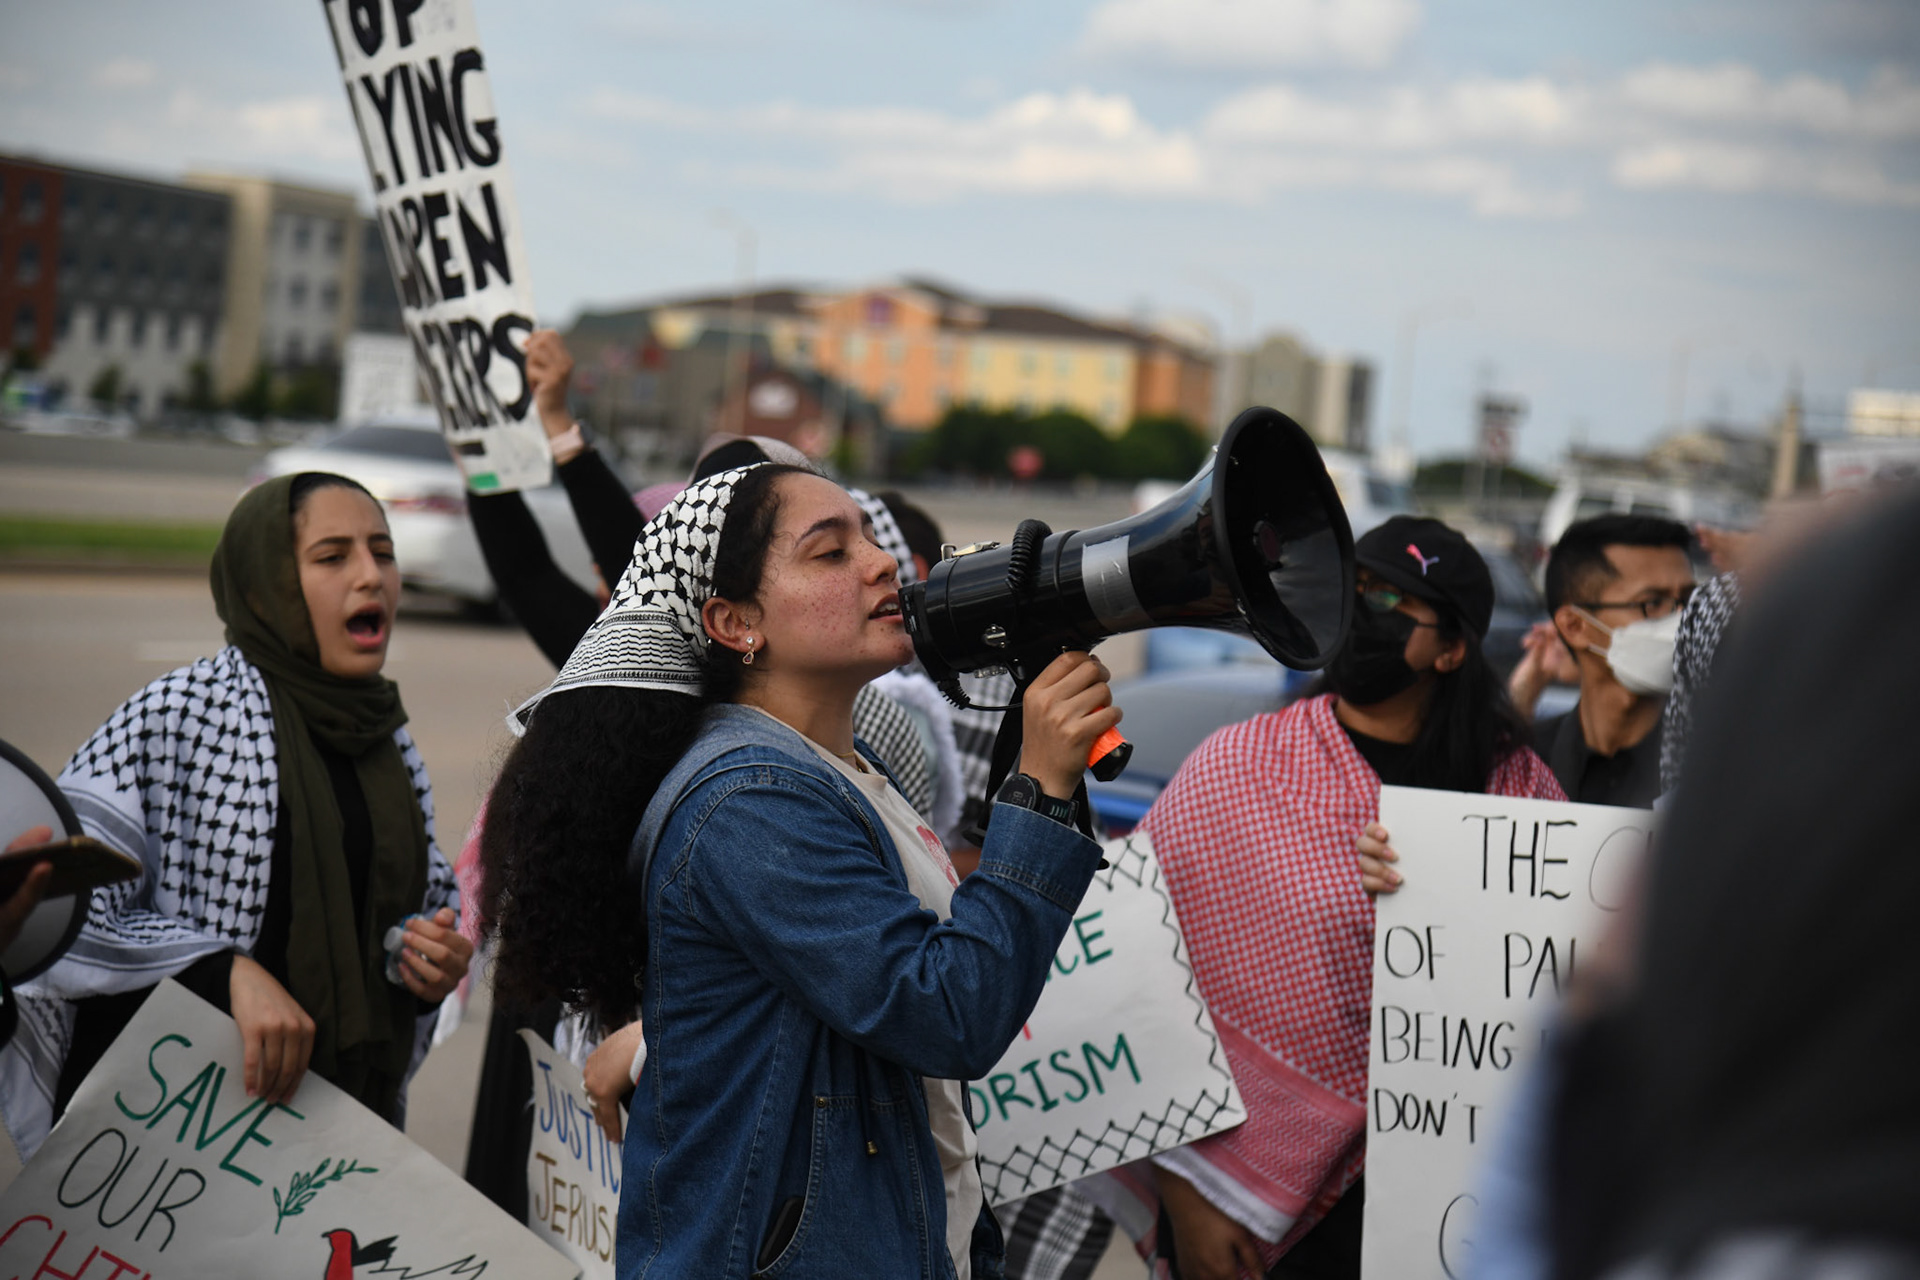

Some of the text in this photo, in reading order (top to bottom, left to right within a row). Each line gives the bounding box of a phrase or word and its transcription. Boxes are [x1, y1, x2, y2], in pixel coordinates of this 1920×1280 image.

[1463, 814, 1578, 900] THE
[1384, 925, 1447, 981] OF
[1381, 1005, 1520, 1071] BEING
[115, 1034, 304, 1187] SAVE
[1374, 1087, 1483, 1144] DON'T
[57, 1128, 206, 1253] OUR
[534, 1151, 618, 1265] JERUS
